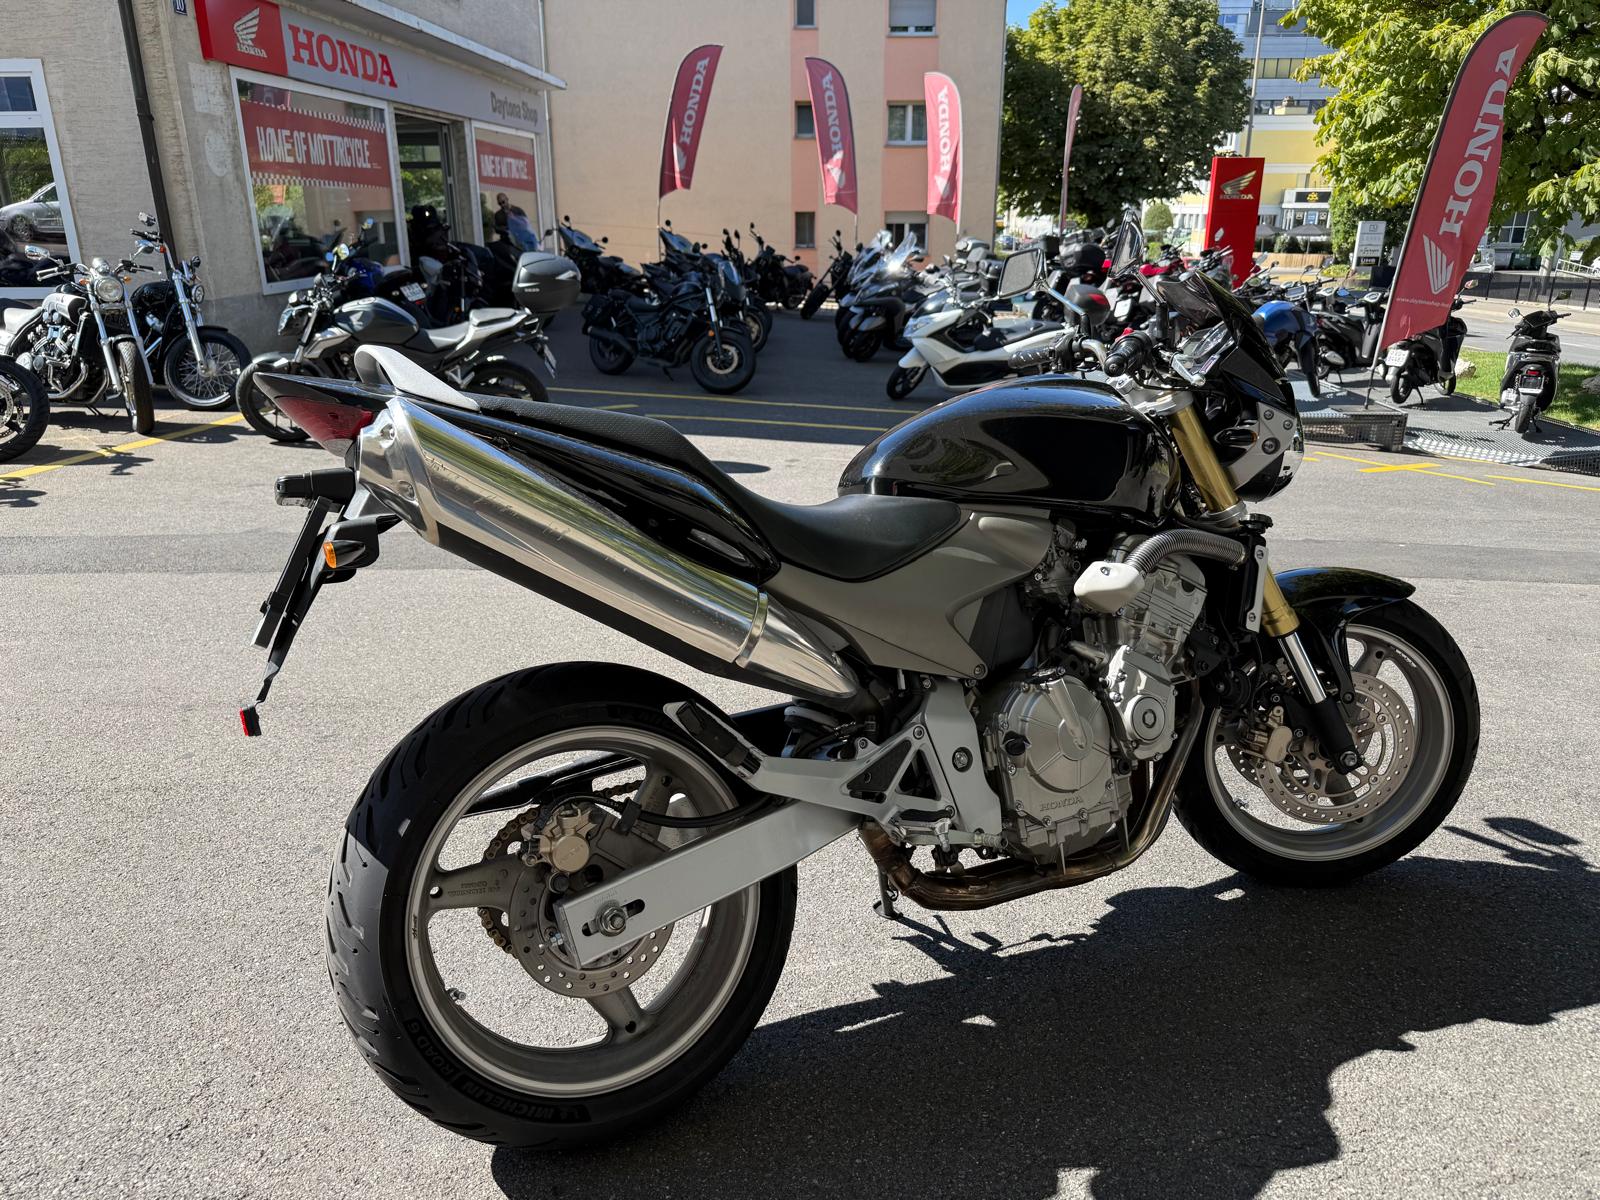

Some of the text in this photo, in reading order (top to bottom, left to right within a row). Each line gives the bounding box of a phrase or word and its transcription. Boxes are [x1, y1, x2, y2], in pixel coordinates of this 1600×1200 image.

[236, 42, 267, 58] HONDA
[288, 24, 398, 88] HONDA
[490, 91, 538, 127] Daytona Shop
[680, 57, 709, 144] HONDA
[256, 126, 294, 163] HOME
[293, 130, 306, 164] OF
[937, 85, 951, 171] HONDA
[1439, 44, 1519, 238] HONDA
[1040, 797, 1084, 811] HONDA
[416, 1035, 456, 1079] ROAD
[460, 1077, 555, 1121] MICHELIN
